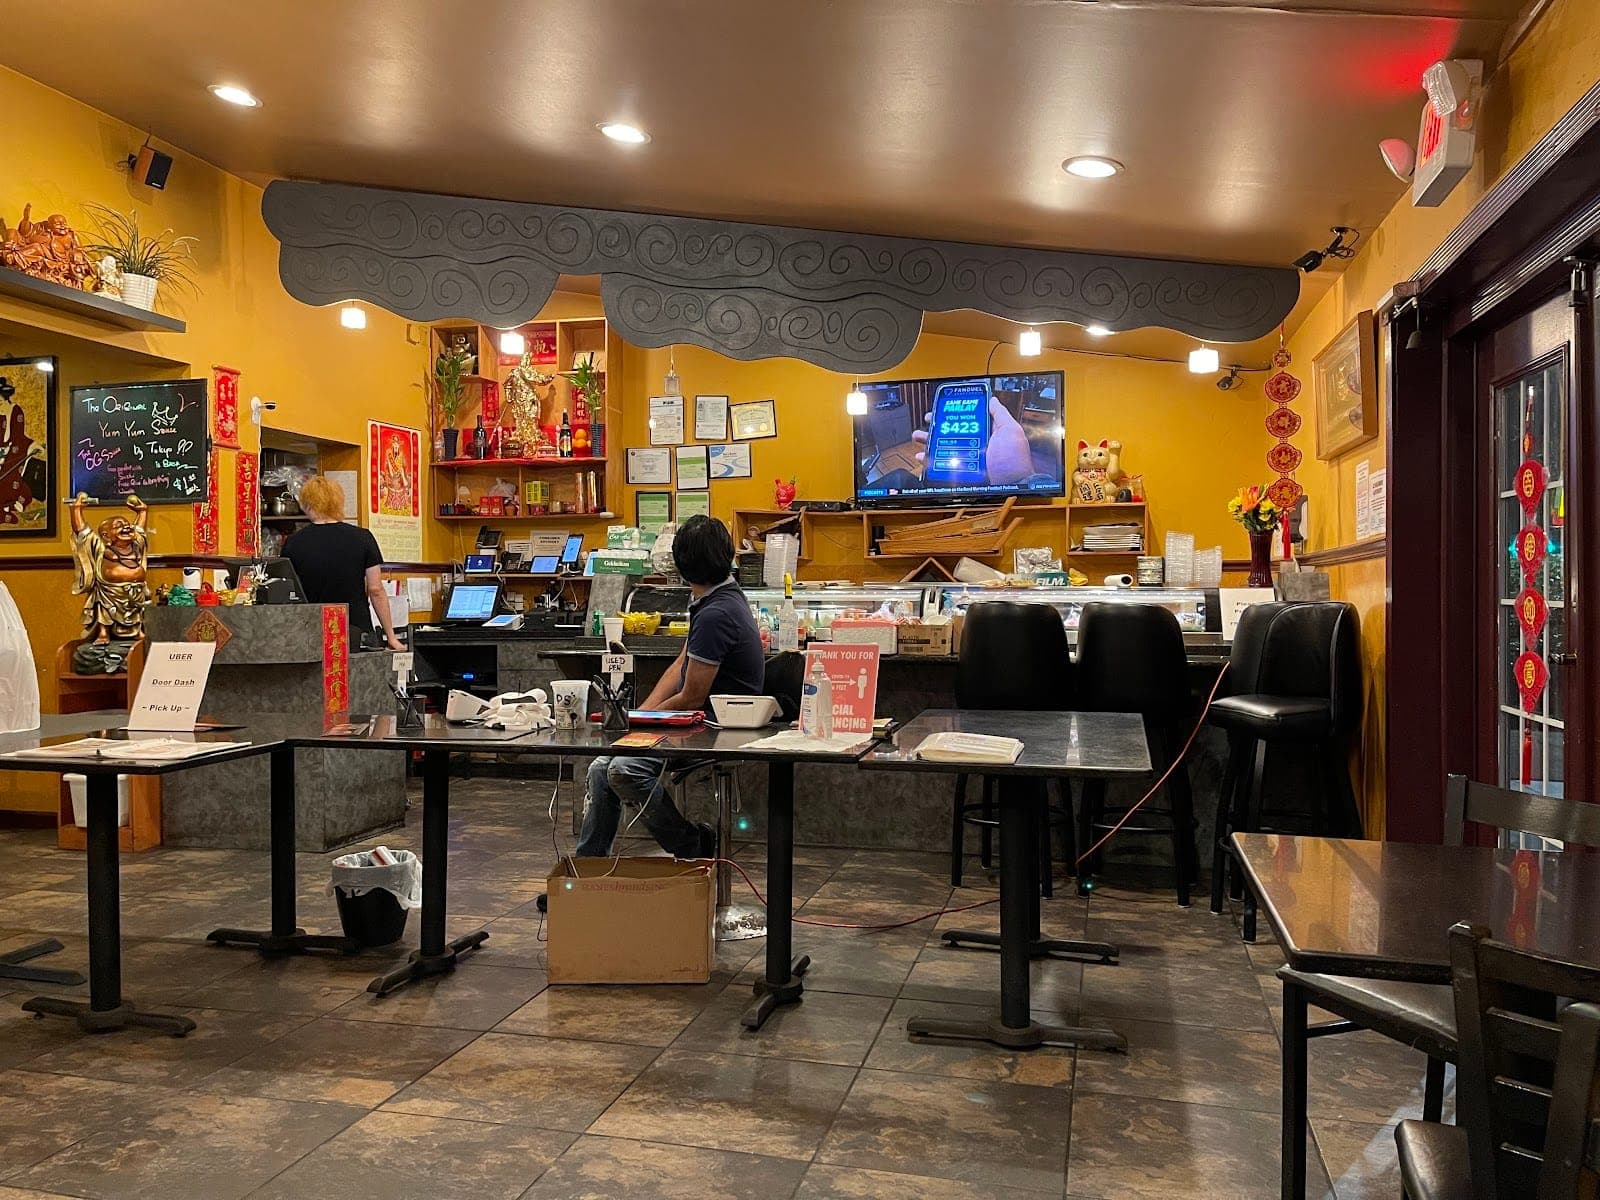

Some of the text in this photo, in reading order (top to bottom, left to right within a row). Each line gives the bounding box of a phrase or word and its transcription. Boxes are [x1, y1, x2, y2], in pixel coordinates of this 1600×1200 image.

[943, 404, 978, 412] PARLAY
[98, 420, 120, 438] Yum
[124, 420, 145, 437] Yum
[940, 421, 980, 434] $423
[813, 651, 874, 660] TANK YOU FOR
[832, 704, 854, 715] CIAL
